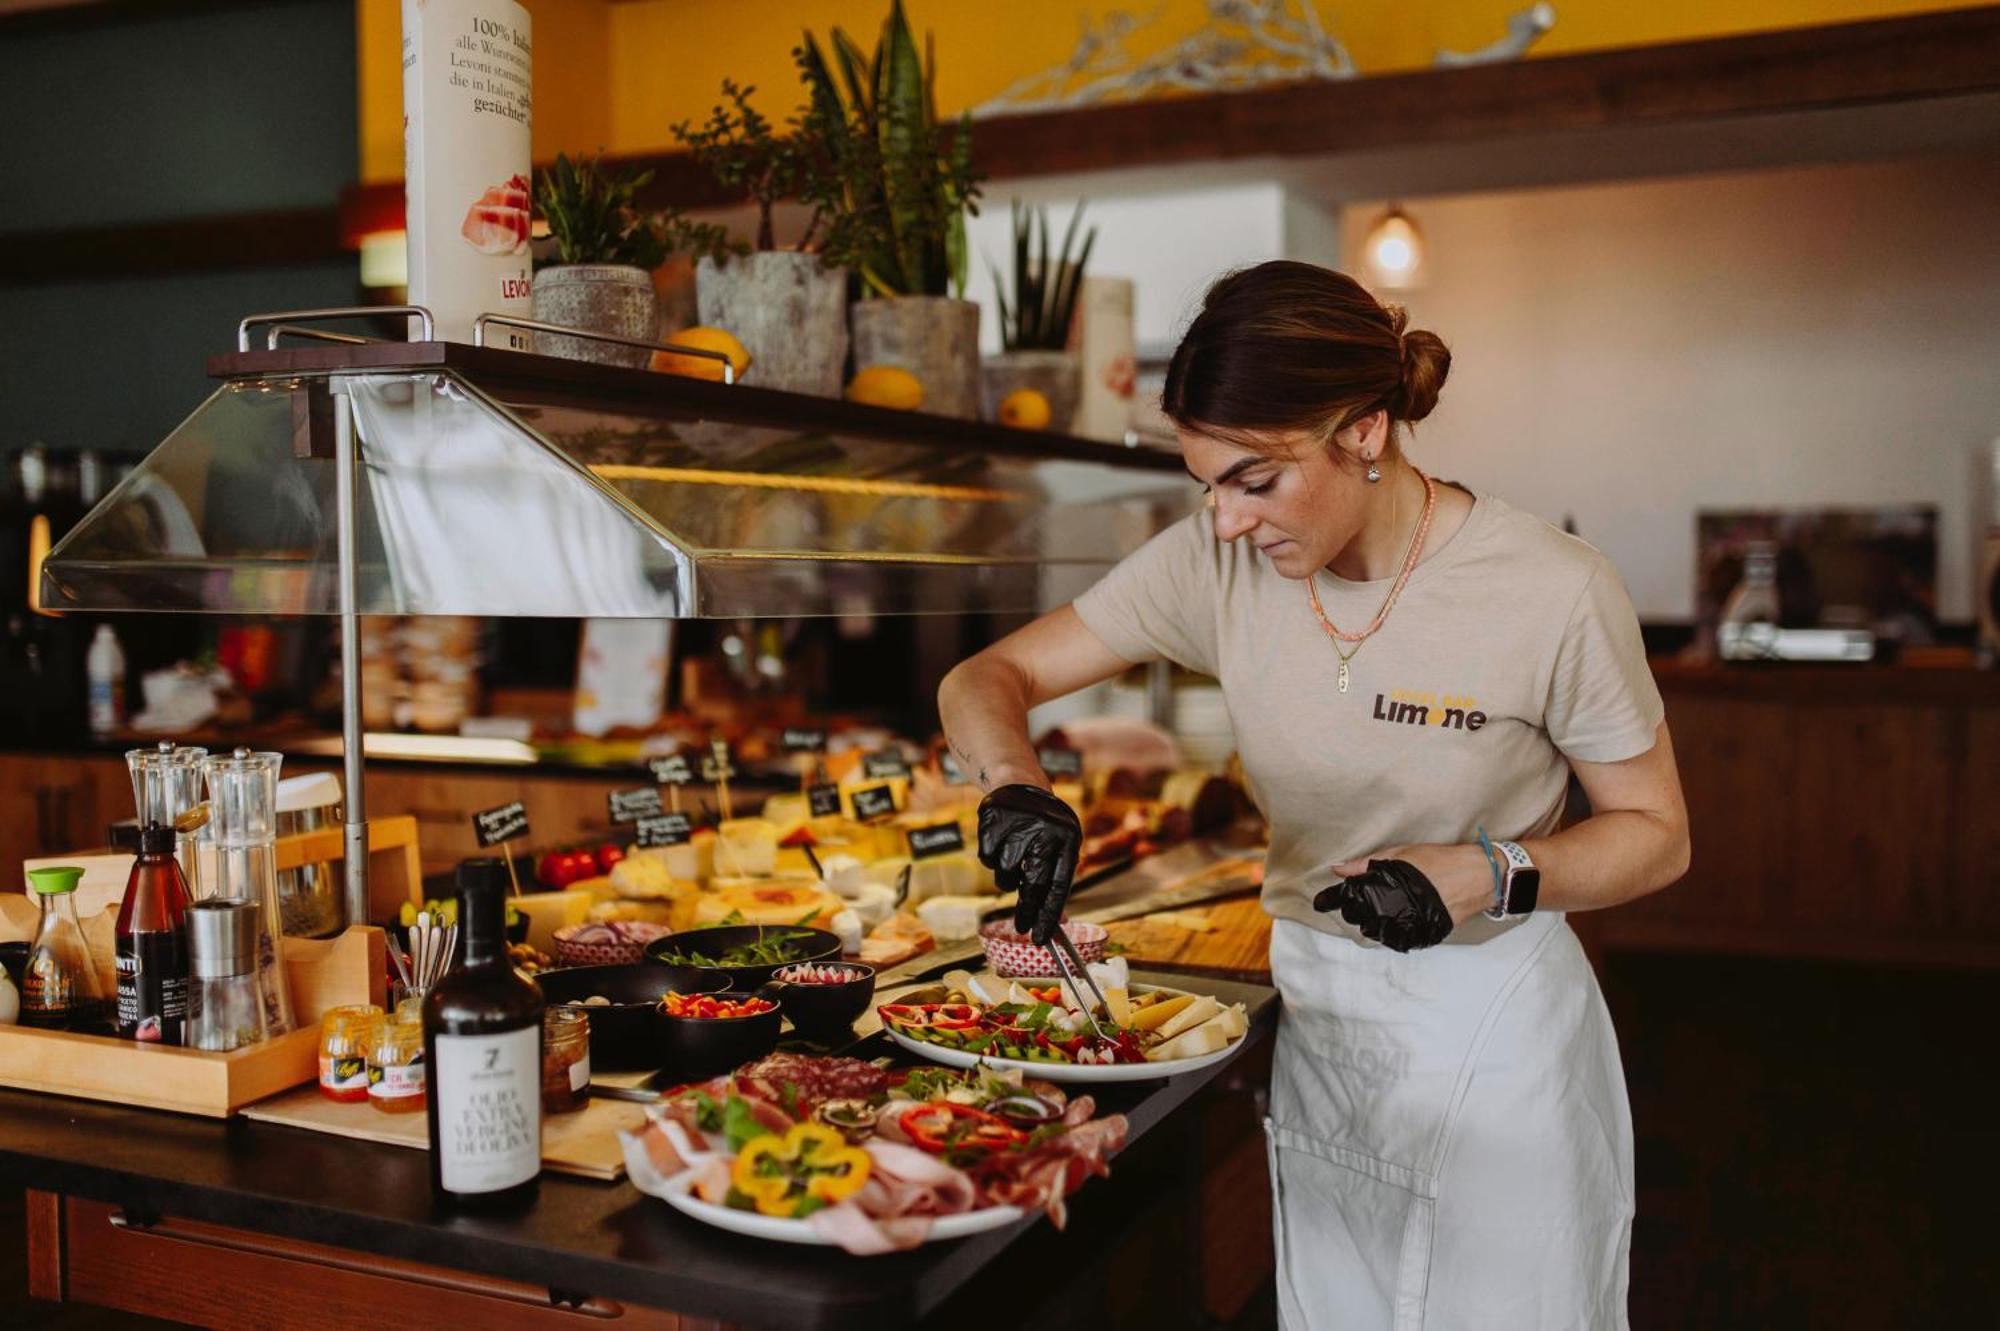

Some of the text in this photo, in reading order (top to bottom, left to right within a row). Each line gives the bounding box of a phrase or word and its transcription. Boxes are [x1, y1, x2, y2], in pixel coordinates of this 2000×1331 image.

[473, 17, 510, 41] 100%
[456, 35, 477, 50] alle
[451, 52, 492, 75] Levoni
[449, 71, 469, 88] die
[473, 80, 484, 90] in
[502, 279, 531, 299] LEVON
